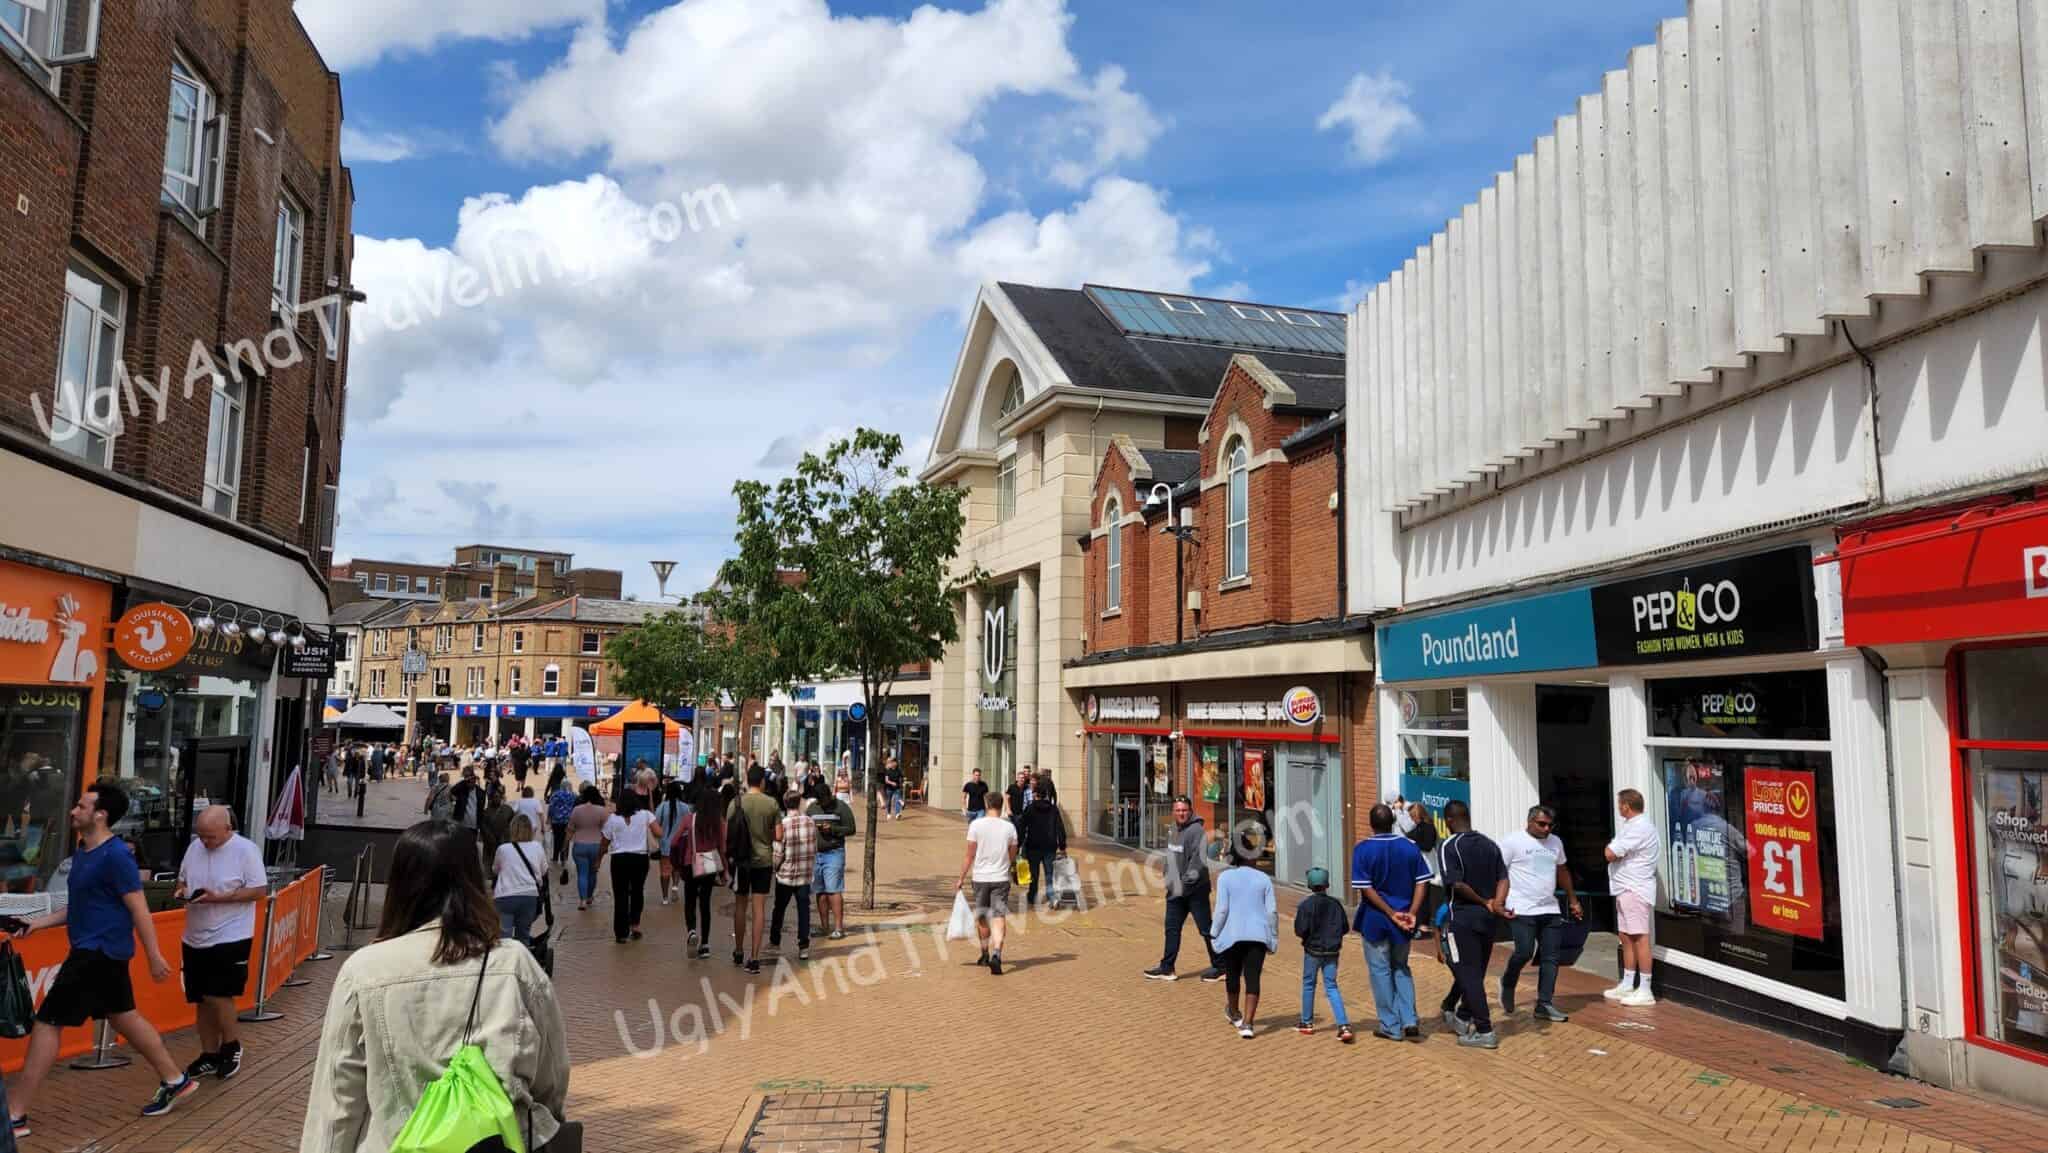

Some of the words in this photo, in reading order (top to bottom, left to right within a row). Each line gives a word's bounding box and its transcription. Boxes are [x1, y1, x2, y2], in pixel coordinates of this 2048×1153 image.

[129, 609, 179, 626] LOUISIANA
[1421, 616, 1519, 666] Poundland
[1662, 637, 1675, 652] FOR
[1703, 630, 1719, 648] MEN
[1720, 632, 1726, 646] &
[1727, 629, 1744, 646] KIDS
[128, 650, 173, 664] KITCHEN
[294, 647, 329, 656] LUSH
[1292, 703, 1317, 714] KING
[1422, 791, 1450, 808] Amazin
[1753, 801, 1785, 816] PRICES
[1995, 811, 2028, 830] Shop
[1754, 823, 1777, 836] 1000s
[1779, 825, 1787, 838] of
[1788, 827, 1811, 841] items
[1762, 840, 1804, 897] £1
[1772, 904, 1782, 914] or
[1782, 904, 1800, 920] less
